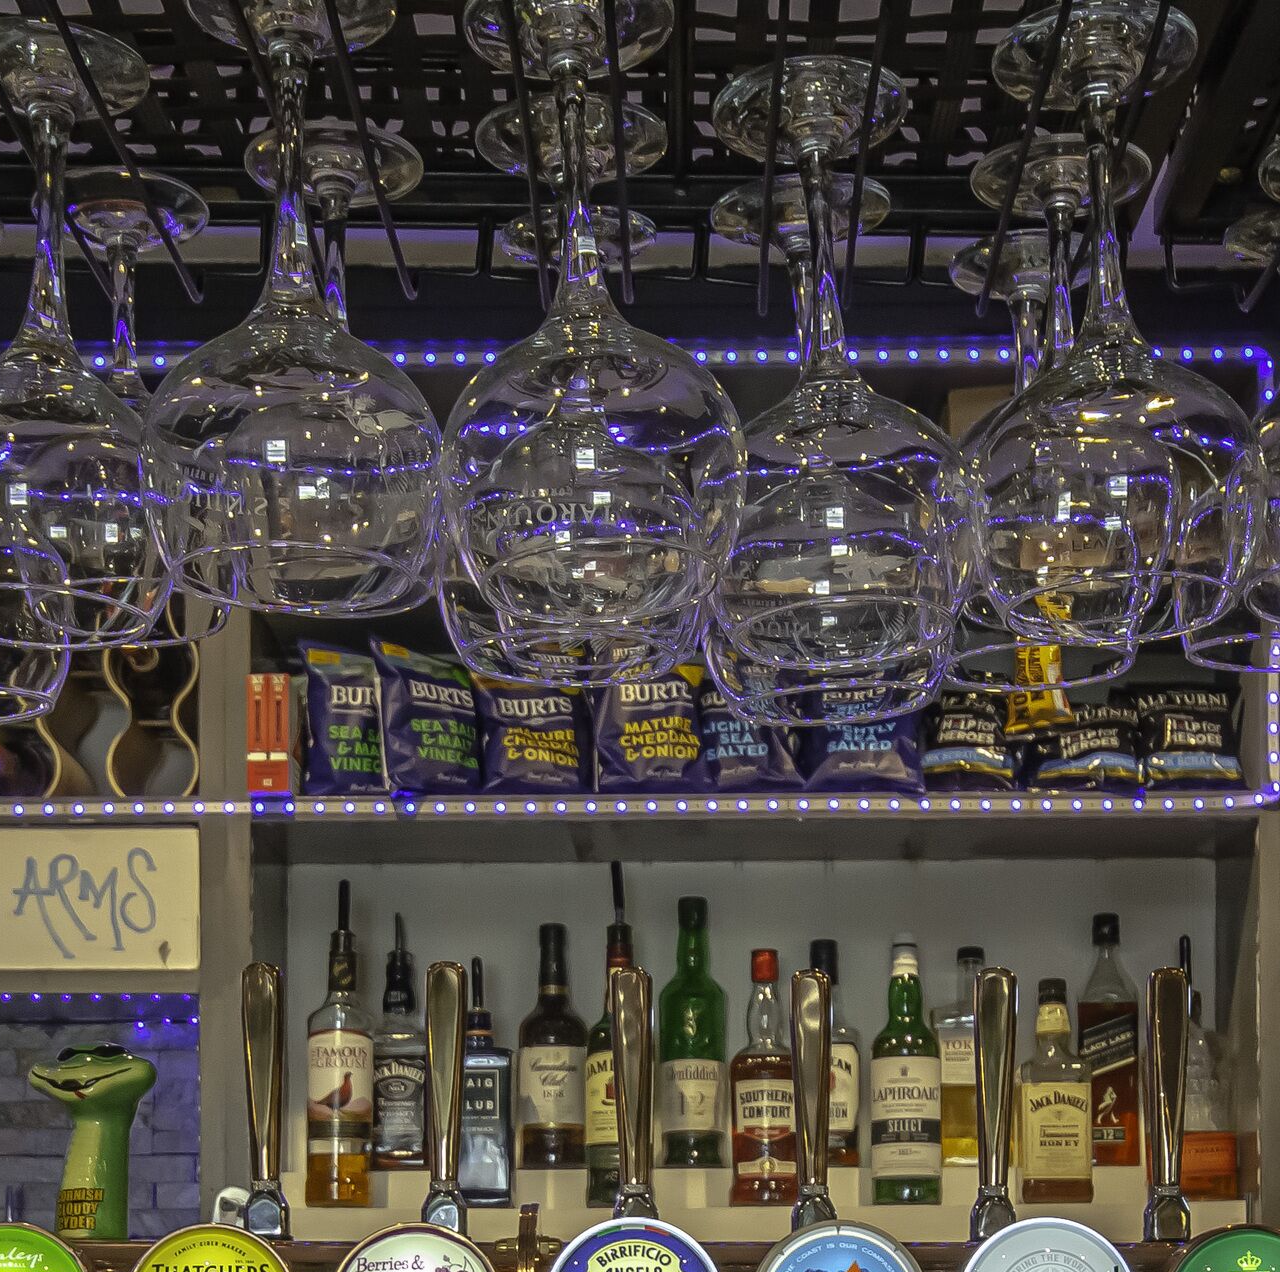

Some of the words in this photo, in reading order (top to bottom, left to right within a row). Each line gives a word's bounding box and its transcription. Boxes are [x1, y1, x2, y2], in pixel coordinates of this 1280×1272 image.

[330, 684, 376, 706] BUR
[409, 679, 475, 708] BURTS
[498, 696, 573, 717] BURTS
[328, 724, 362, 741] SEA
[411, 719, 444, 738] SEA
[625, 715, 692, 733] MATURE
[619, 730, 701, 748] CHEDDAR
[720, 732, 755, 745] SEA
[826, 740, 894, 754] SALTED
[525, 748, 578, 769] ONION
[643, 745, 701, 762] ONION
[706, 743, 769, 760] SALTED
[315, 1046, 368, 1058] FAMOUS
[942, 1038, 973, 1051] TOK
[315, 1057, 368, 1069] GROUSE
[466, 1077, 494, 1089] AIG
[539, 1072, 569, 1086] Club
[739, 1088, 794, 1105] SOUTHERN
[1029, 1093, 1052, 1114] JACK
[465, 1100, 495, 1112] LUB
[742, 1105, 791, 1119] COMFORT
[887, 1119, 923, 1132] SELECT
[1103, 1129, 1115, 1140] 12
[1039, 1139, 1080, 1148] HONEY
[174, 1243, 197, 1258] FAMILY
[199, 1240, 219, 1248] CIDER
[221, 1241, 247, 1258] MAKERS
[595, 1244, 672, 1267] BIRRIFICIO
[795, 1245, 823, 1264] COAST
[825, 1242, 836, 1250] IS
[838, 1242, 858, 1251] OUR
[1040, 1253, 1060, 1262] THE
[411, 1254, 425, 1271] &
